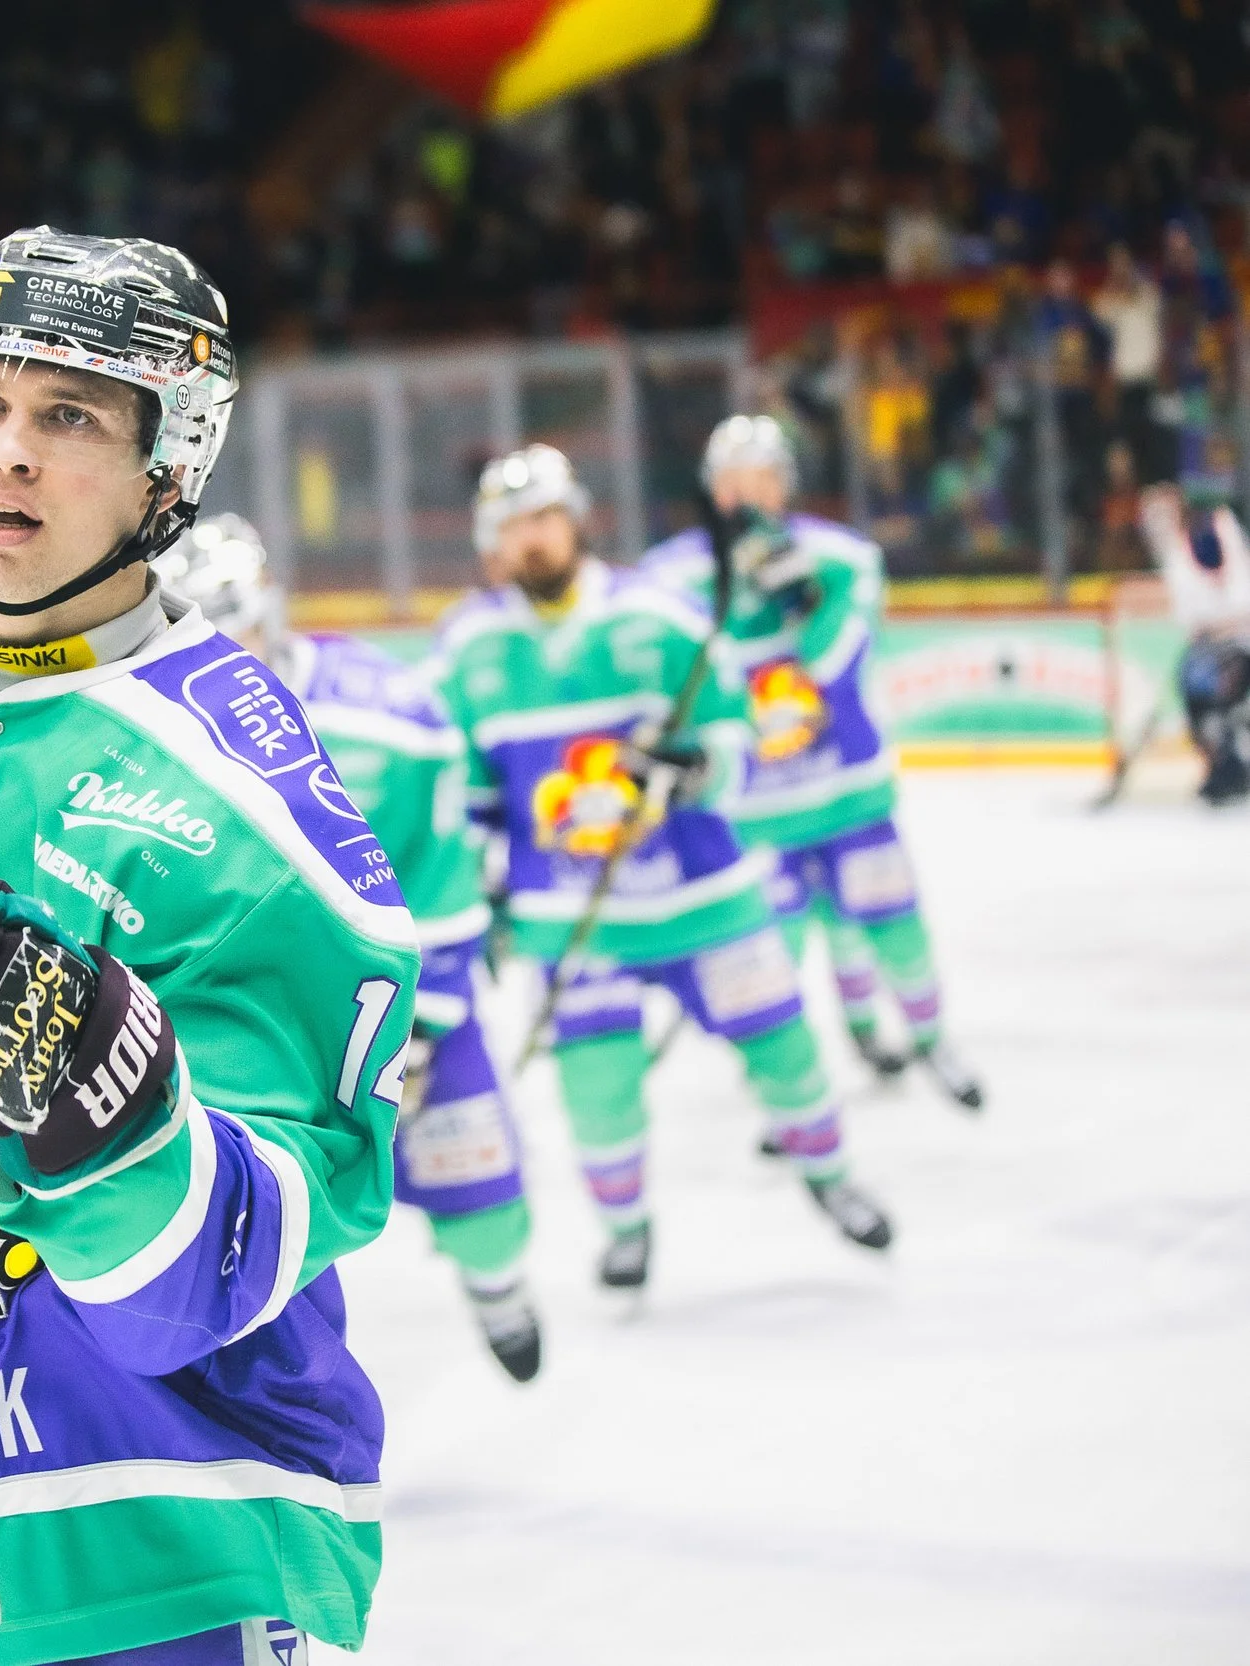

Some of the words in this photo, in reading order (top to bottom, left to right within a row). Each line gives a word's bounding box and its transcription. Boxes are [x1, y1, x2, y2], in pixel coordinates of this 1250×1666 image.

[25, 290, 123, 321] TECHNOLOGY
[26, 276, 126, 310] CREATIVE
[49, 316, 70, 330] Live
[71, 322, 104, 338] Events
[0, 339, 71, 360] GLASSDRIVE
[107, 361, 169, 386] GLASSDRIVE
[227, 692, 288, 759] link
[141, 850, 171, 879] OLUT
[351, 866, 397, 893] KAIV
